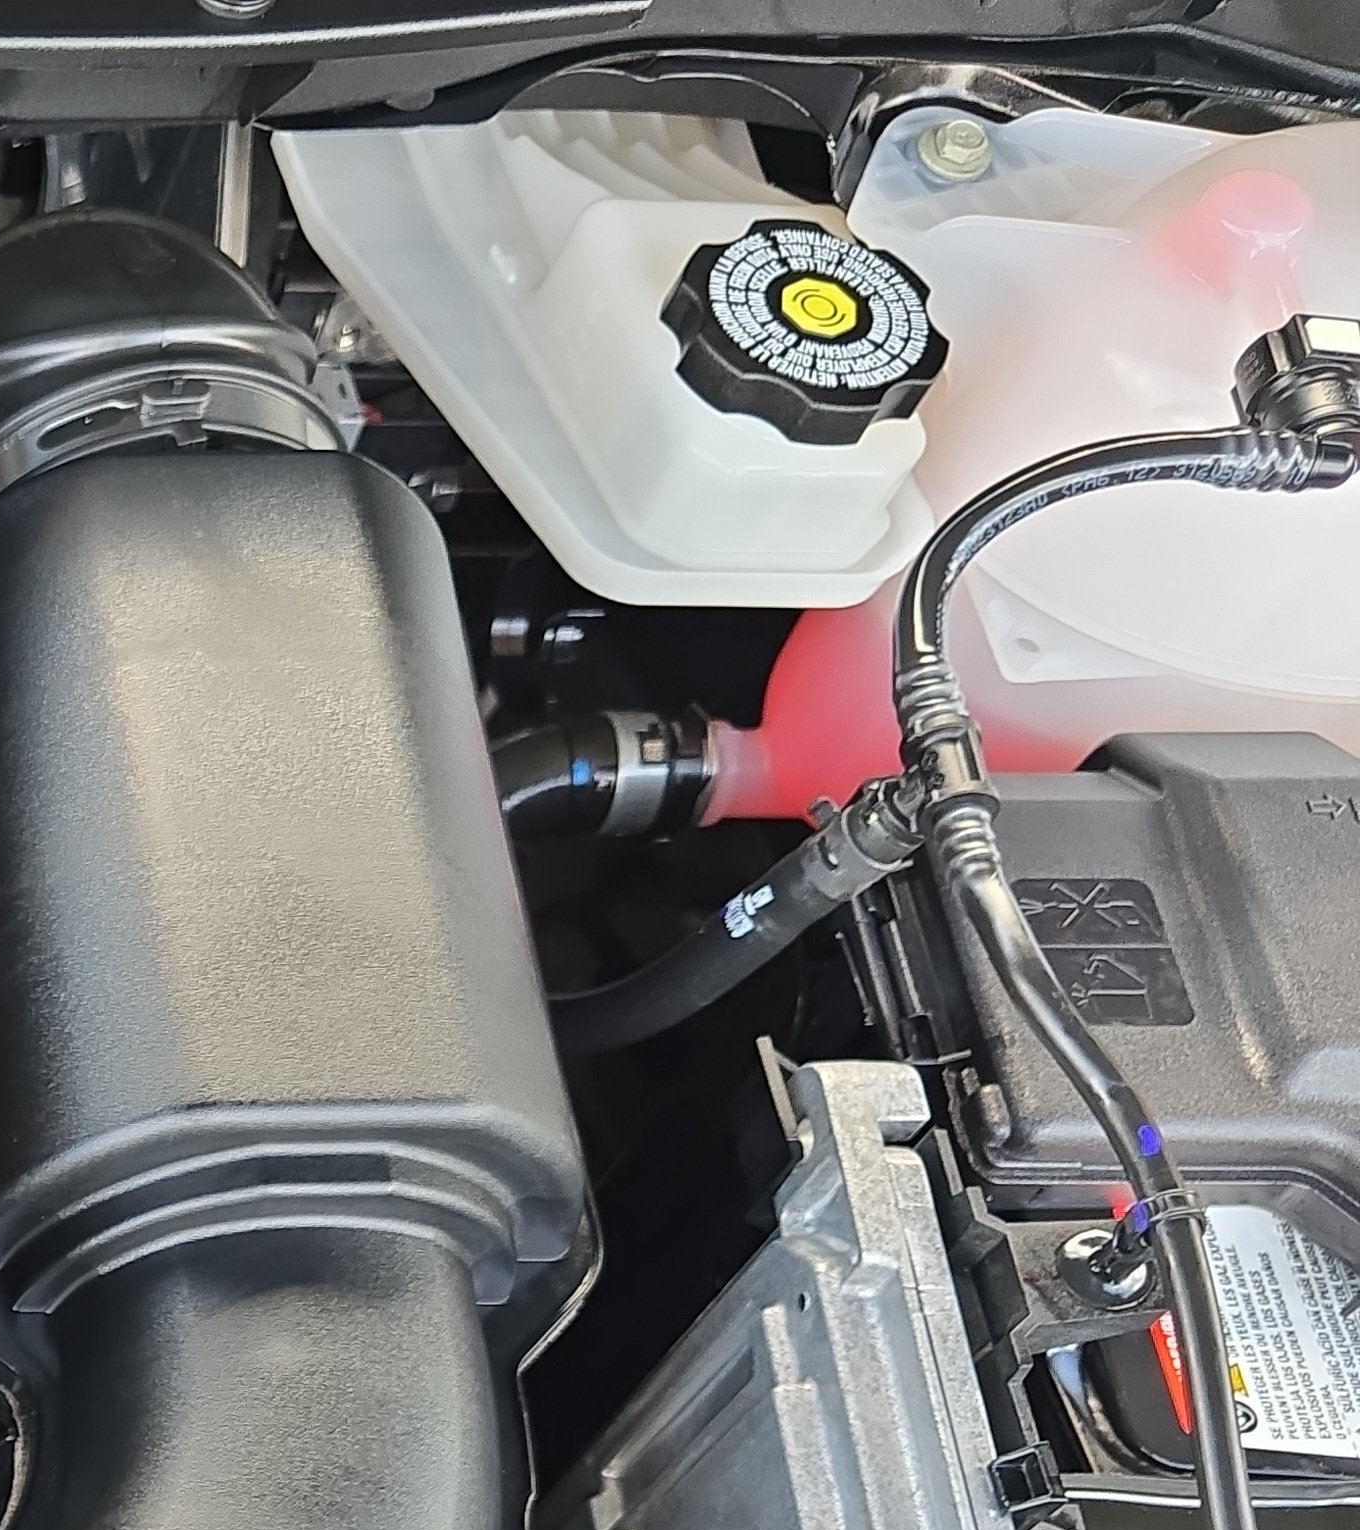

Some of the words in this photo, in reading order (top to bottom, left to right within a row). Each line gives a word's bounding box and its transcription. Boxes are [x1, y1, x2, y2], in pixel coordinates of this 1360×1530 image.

[773, 244, 812, 259] ONLY
[812, 245, 840, 264] USE
[848, 243, 898, 278] SEALED
[784, 258, 836, 277] FILLER
[709, 269, 731, 302] AVANT
[832, 265, 875, 297] CLEAN
[730, 287, 750, 303] DE
[891, 281, 925, 311] FROM
[712, 302, 758, 349] BOUCHON
[732, 303, 771, 341] LIQUIDE
[883, 300, 908, 339] BEFORE
[906, 311, 929, 341] FLUID
[796, 336, 878, 359] PROVENANT
[880, 333, 907, 356] CAP
[783, 347, 813, 369] QUE
[766, 354, 840, 388] NETTOYER
[1225, 1287, 1239, 1307] LES
[1265, 1308, 1280, 1328] LOS
[1244, 1344, 1259, 1363] LES
[1319, 1333, 1336, 1358] ACID
[1285, 1367, 1298, 1386] LOS
[1303, 1372, 1331, 1439] EXPLOSIVOS
